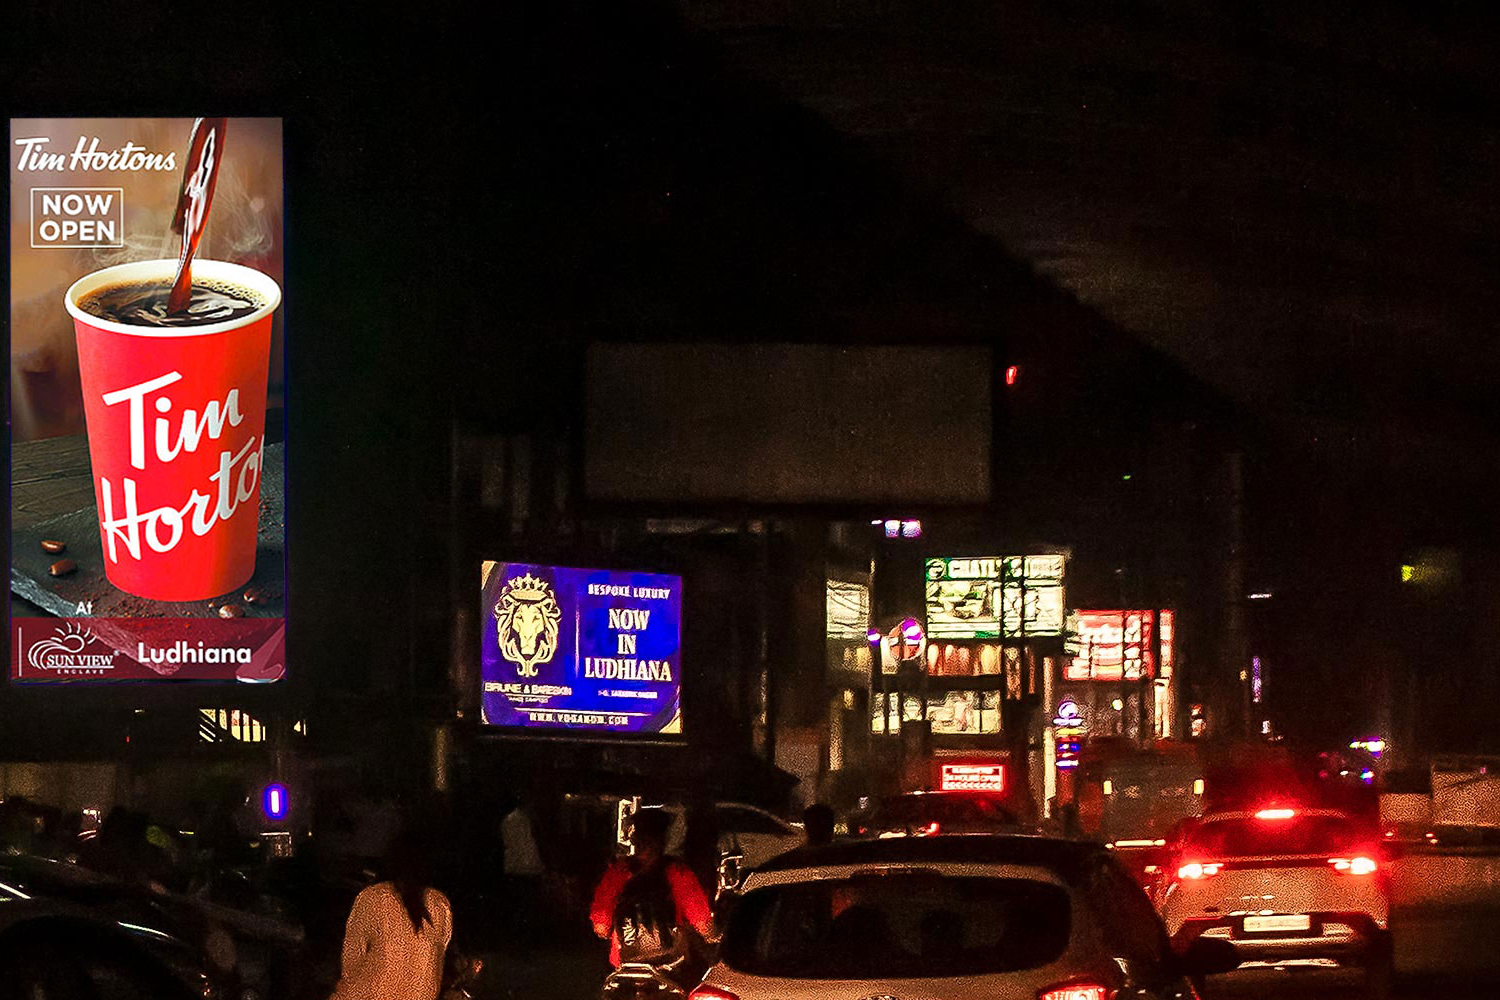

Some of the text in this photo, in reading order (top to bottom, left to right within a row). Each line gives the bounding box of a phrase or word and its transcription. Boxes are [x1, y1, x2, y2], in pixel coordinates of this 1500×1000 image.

[15, 135, 177, 172] Tim Hortons
[42, 194, 113, 216] NOW
[39, 220, 115, 241] OPEN
[102, 371, 244, 470] Tim
[101, 434, 265, 564] Horto
[588, 584, 670, 600] BESPOKE LUXURY
[76, 601, 92, 615] At
[608, 608, 650, 631] NOW
[138, 641, 252, 664] Ludhiana
[617, 634, 636, 654] IN
[47, 655, 114, 667] SUN VIEW
[584, 657, 672, 682] LUDHIANA
